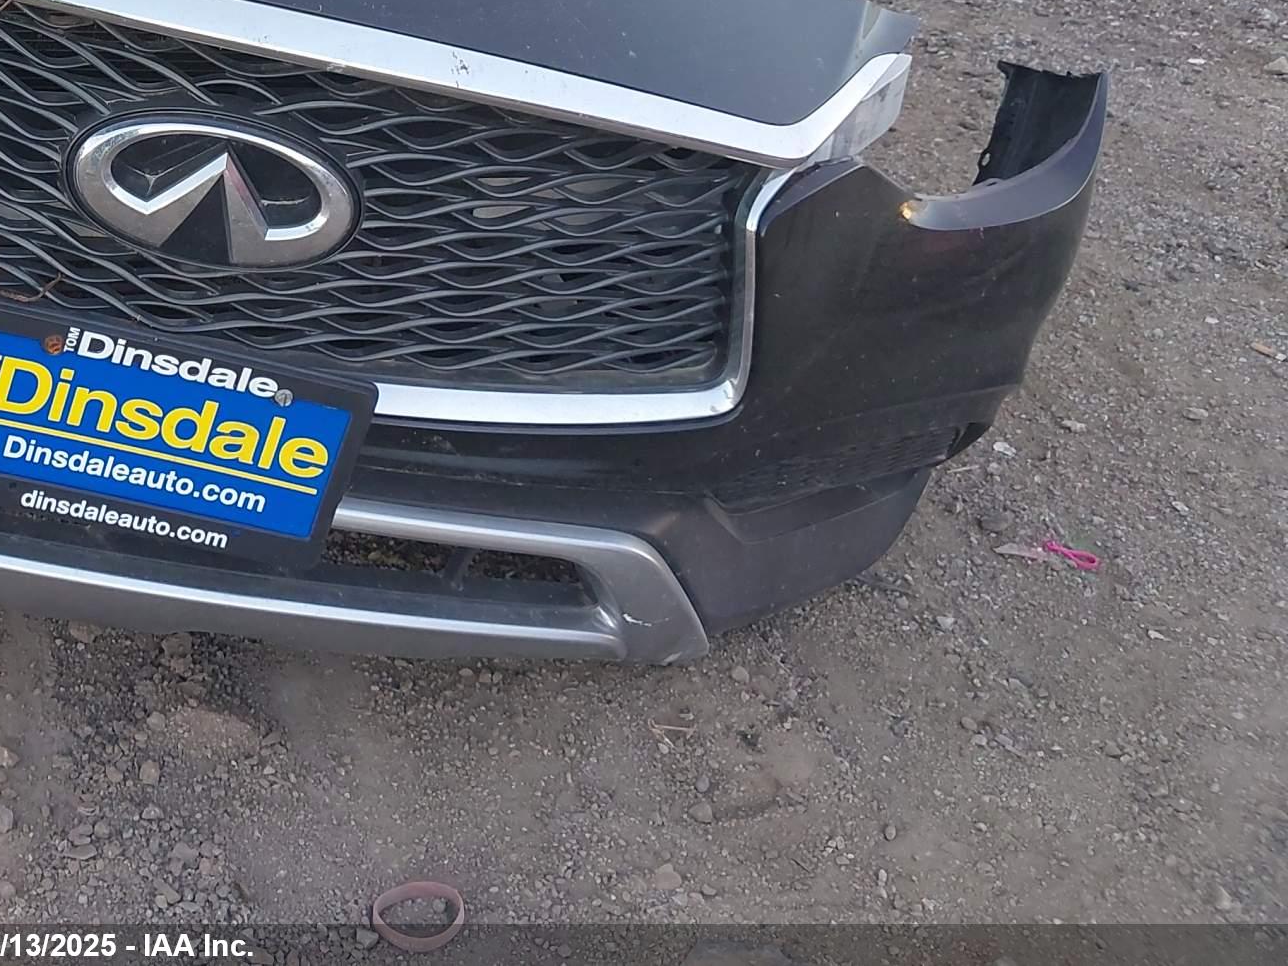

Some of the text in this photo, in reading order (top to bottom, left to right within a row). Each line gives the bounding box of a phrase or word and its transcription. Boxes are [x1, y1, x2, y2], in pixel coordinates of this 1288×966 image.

[64, 327, 280, 398] TOM Dinsdale
[3, 434, 267, 513] Dinsdaleauto.com
[20, 490, 229, 549] dinsdaleauto.com
